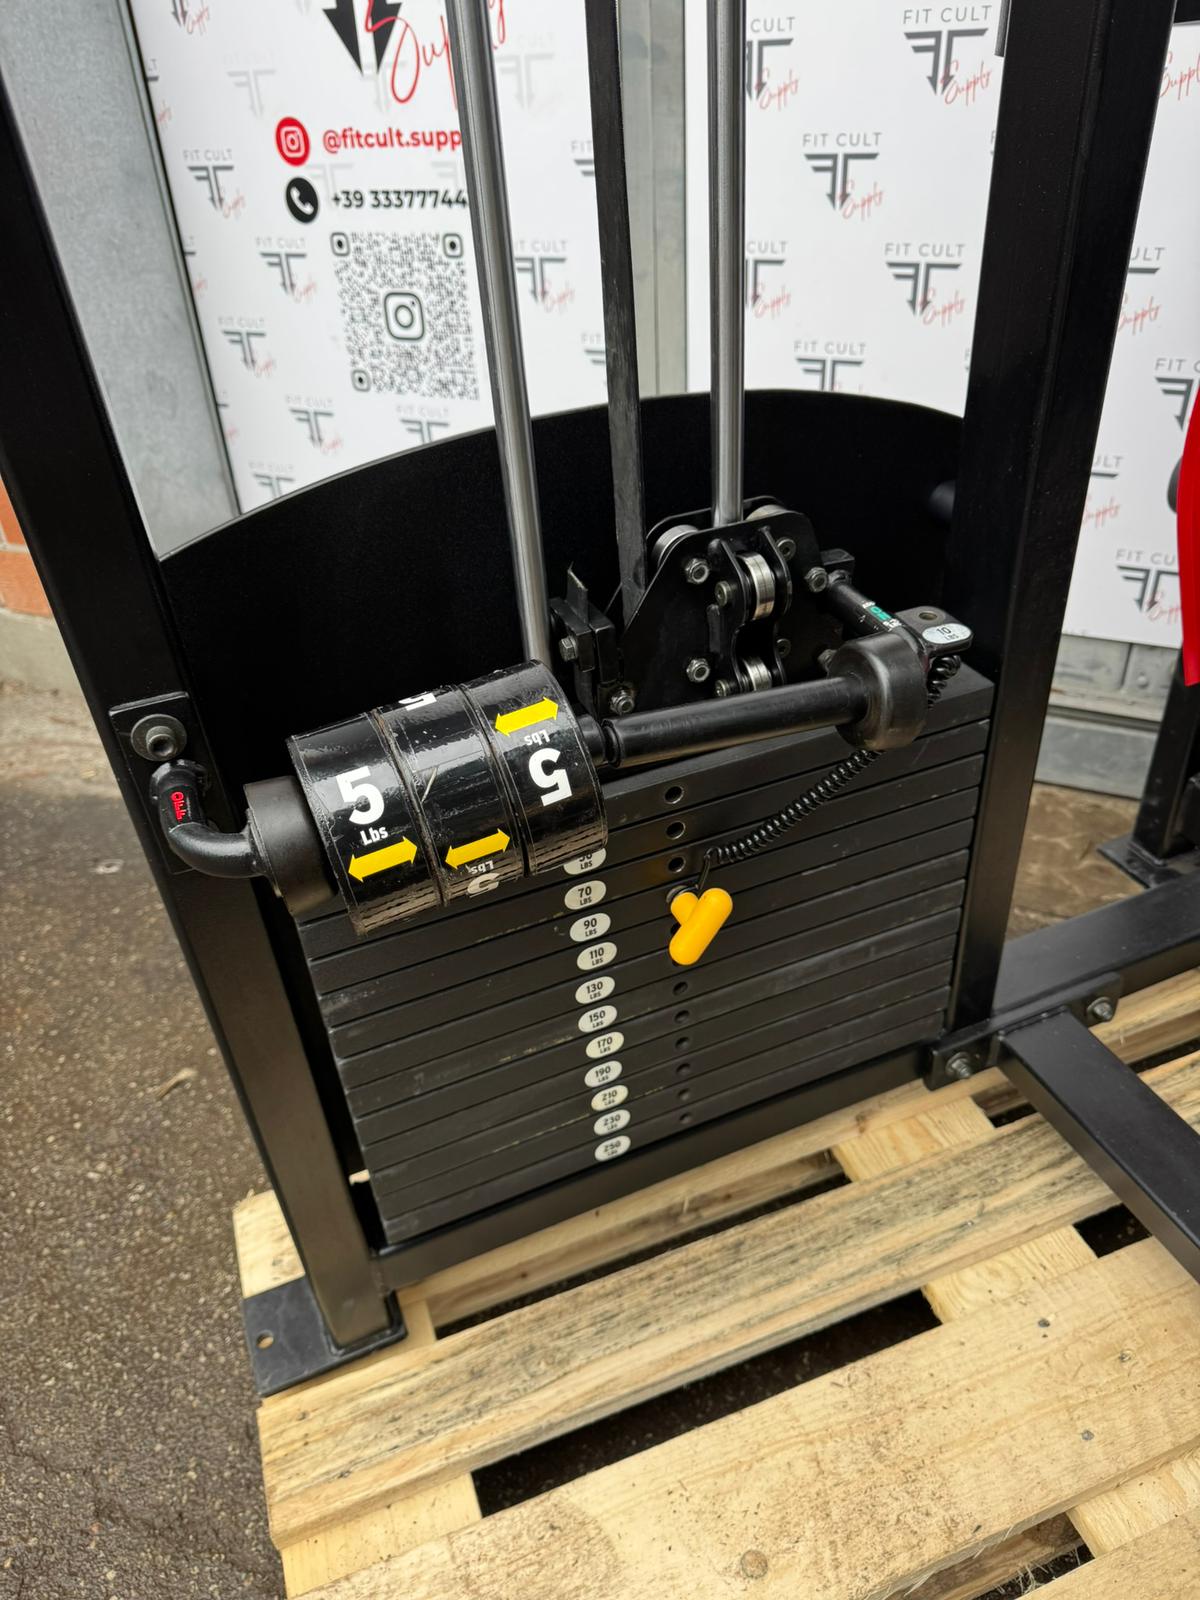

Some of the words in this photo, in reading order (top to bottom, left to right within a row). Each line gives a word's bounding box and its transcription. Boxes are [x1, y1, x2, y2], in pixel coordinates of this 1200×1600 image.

[903, 8, 932, 24] FIT
[940, 5, 992, 23] CULT
[750, 16, 796, 33] CULT
[802, 133, 829, 147] FIT
[835, 131, 882, 147] CULT
[332, 190, 364, 209] +39
[531, 240, 567, 252] CULT
[746, 240, 788, 254] CULT
[884, 242, 911, 256] FIT
[918, 243, 965, 257] CULT
[1130, 246, 1165, 261] ULT
[793, 340, 818, 353] FIT
[824, 341, 867, 356] CULT
[1154, 357, 1187, 372] FIT
[1116, 548, 1145, 562] FIT
[936, 627, 951, 635] 10
[524, 729, 551, 746] Lbs
[528, 747, 573, 807] 5
[335, 766, 385, 825] 5
[360, 826, 389, 846] Lbs
[580, 860, 593, 870] LBS
[578, 886, 592, 897] 70
[579, 896, 592, 906] LBS
[583, 917, 598, 930] 90
[585, 928, 598, 937] LBS
[589, 947, 604, 959] 110
[586, 981, 603, 994] 130
[588, 1009, 606, 1023] 150
[596, 1036, 613, 1049] 170
[594, 1065, 611, 1079] 190
[601, 1089, 618, 1102] 210
[603, 1115, 621, 1127] 230
[604, 1141, 621, 1153] 250
